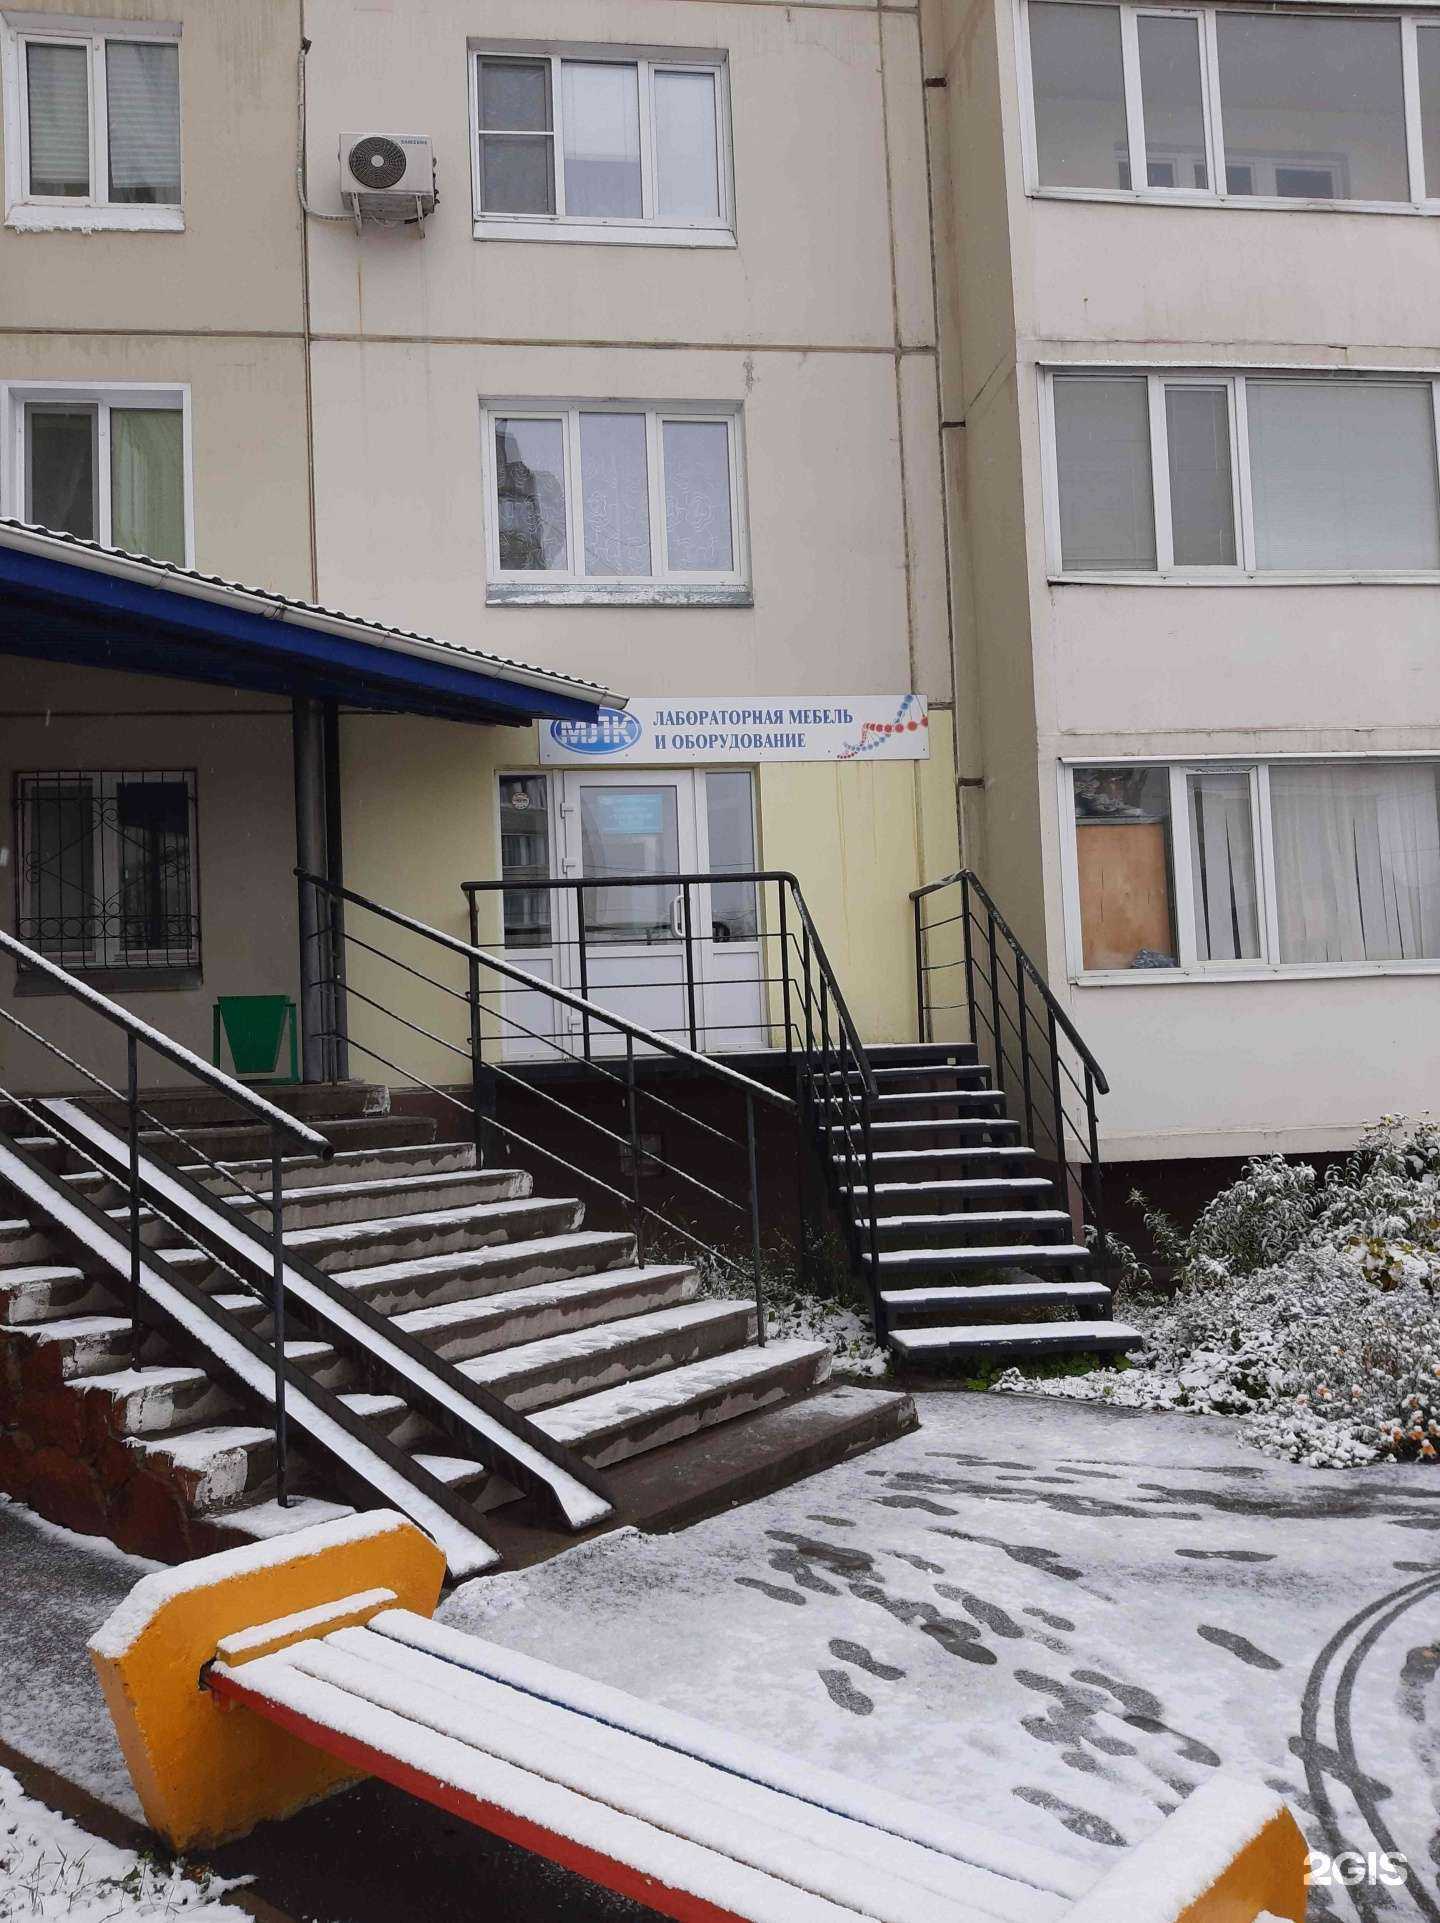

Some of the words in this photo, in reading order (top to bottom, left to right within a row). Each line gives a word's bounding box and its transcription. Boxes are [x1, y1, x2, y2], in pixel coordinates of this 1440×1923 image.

[652, 709, 784, 726] ЛАБОРАТОРНАЯ
[788, 708, 853, 725] МЕБЕЛЬ
[655, 734, 667, 750] И
[671, 732, 807, 752] ОБОРУДОВАНИЕ
